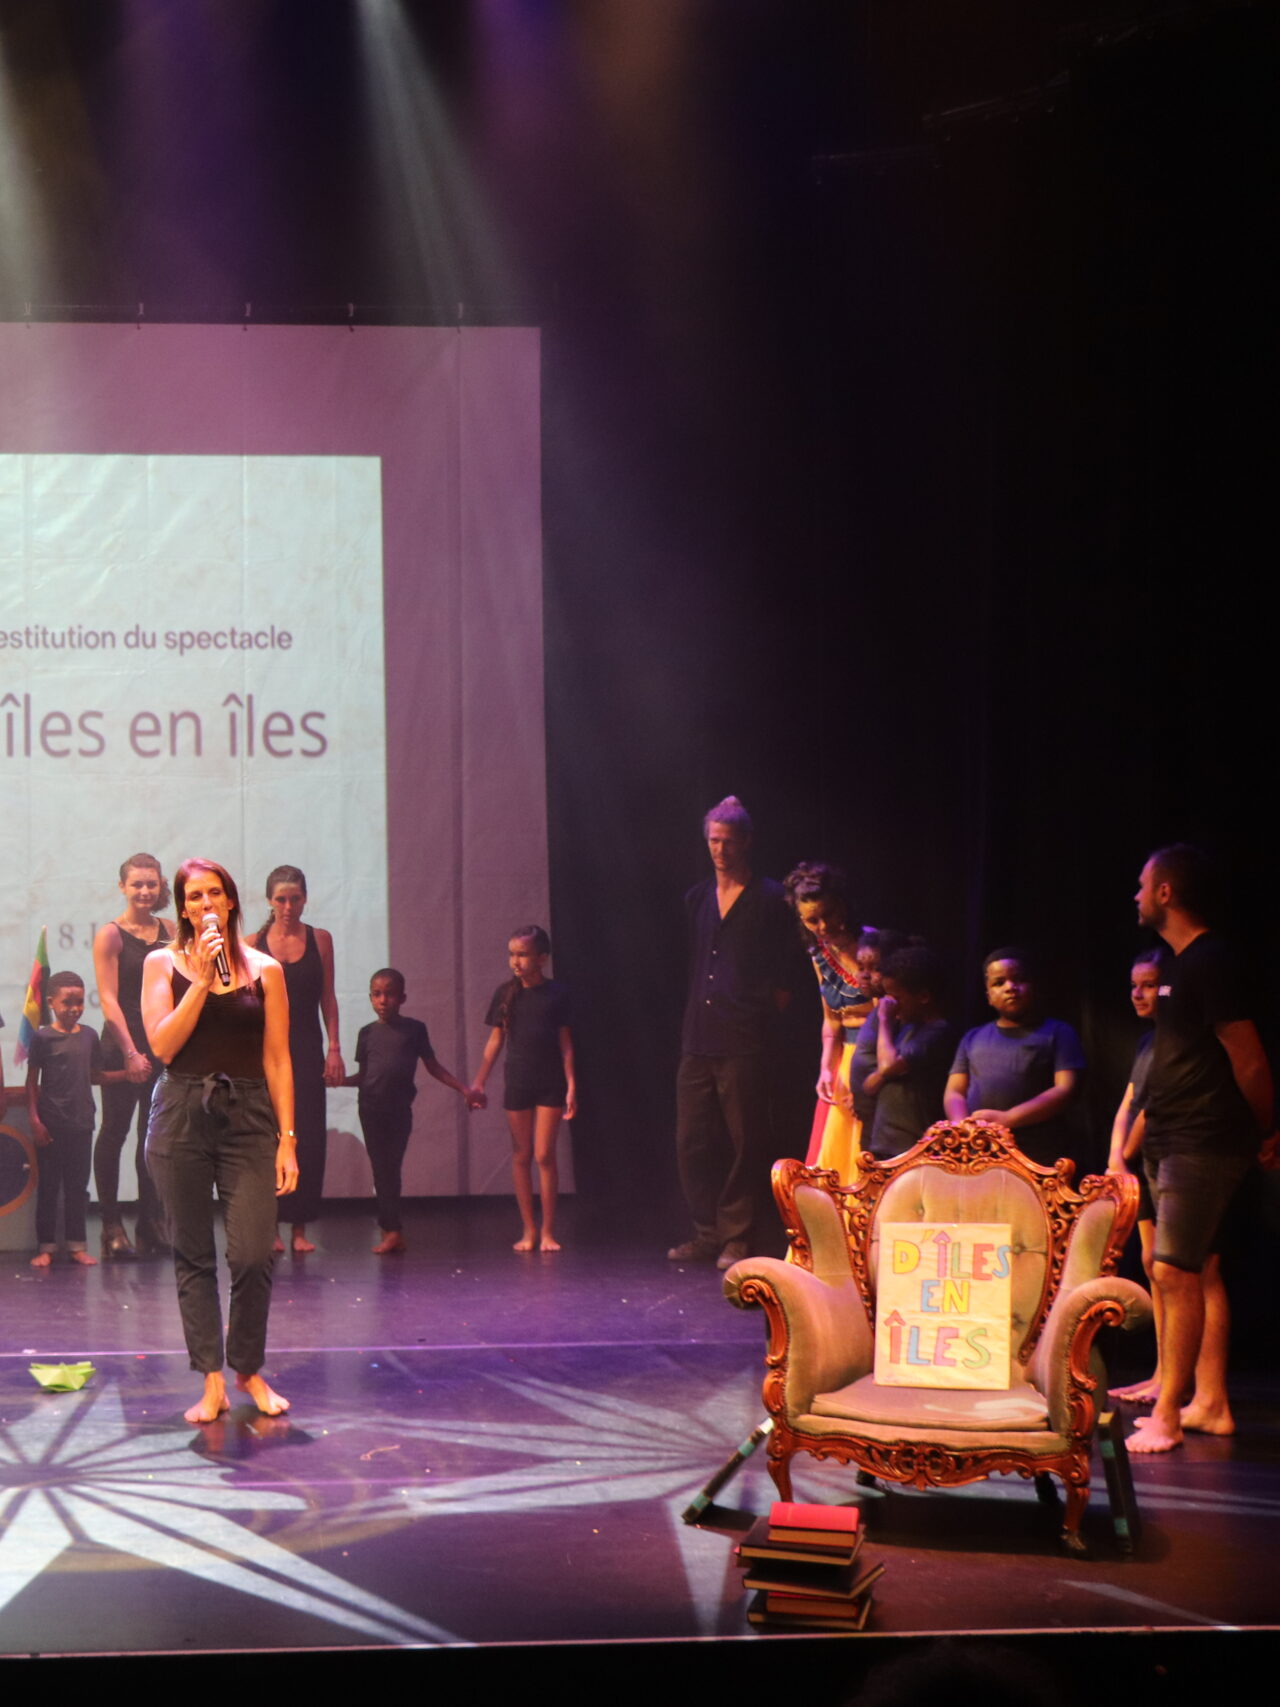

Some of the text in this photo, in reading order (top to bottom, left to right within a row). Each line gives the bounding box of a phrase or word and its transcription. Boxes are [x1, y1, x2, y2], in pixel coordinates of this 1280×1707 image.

[124, 624, 157, 650] du
[164, 624, 293, 656] spectacle
[129, 711, 202, 758] en
[222, 692, 328, 758] îles
[59, 922, 74, 950] 8
[892, 1229, 1011, 1281] D'ÎLES
[921, 1279, 969, 1313] EN
[884, 1309, 991, 1369] ÎLES
